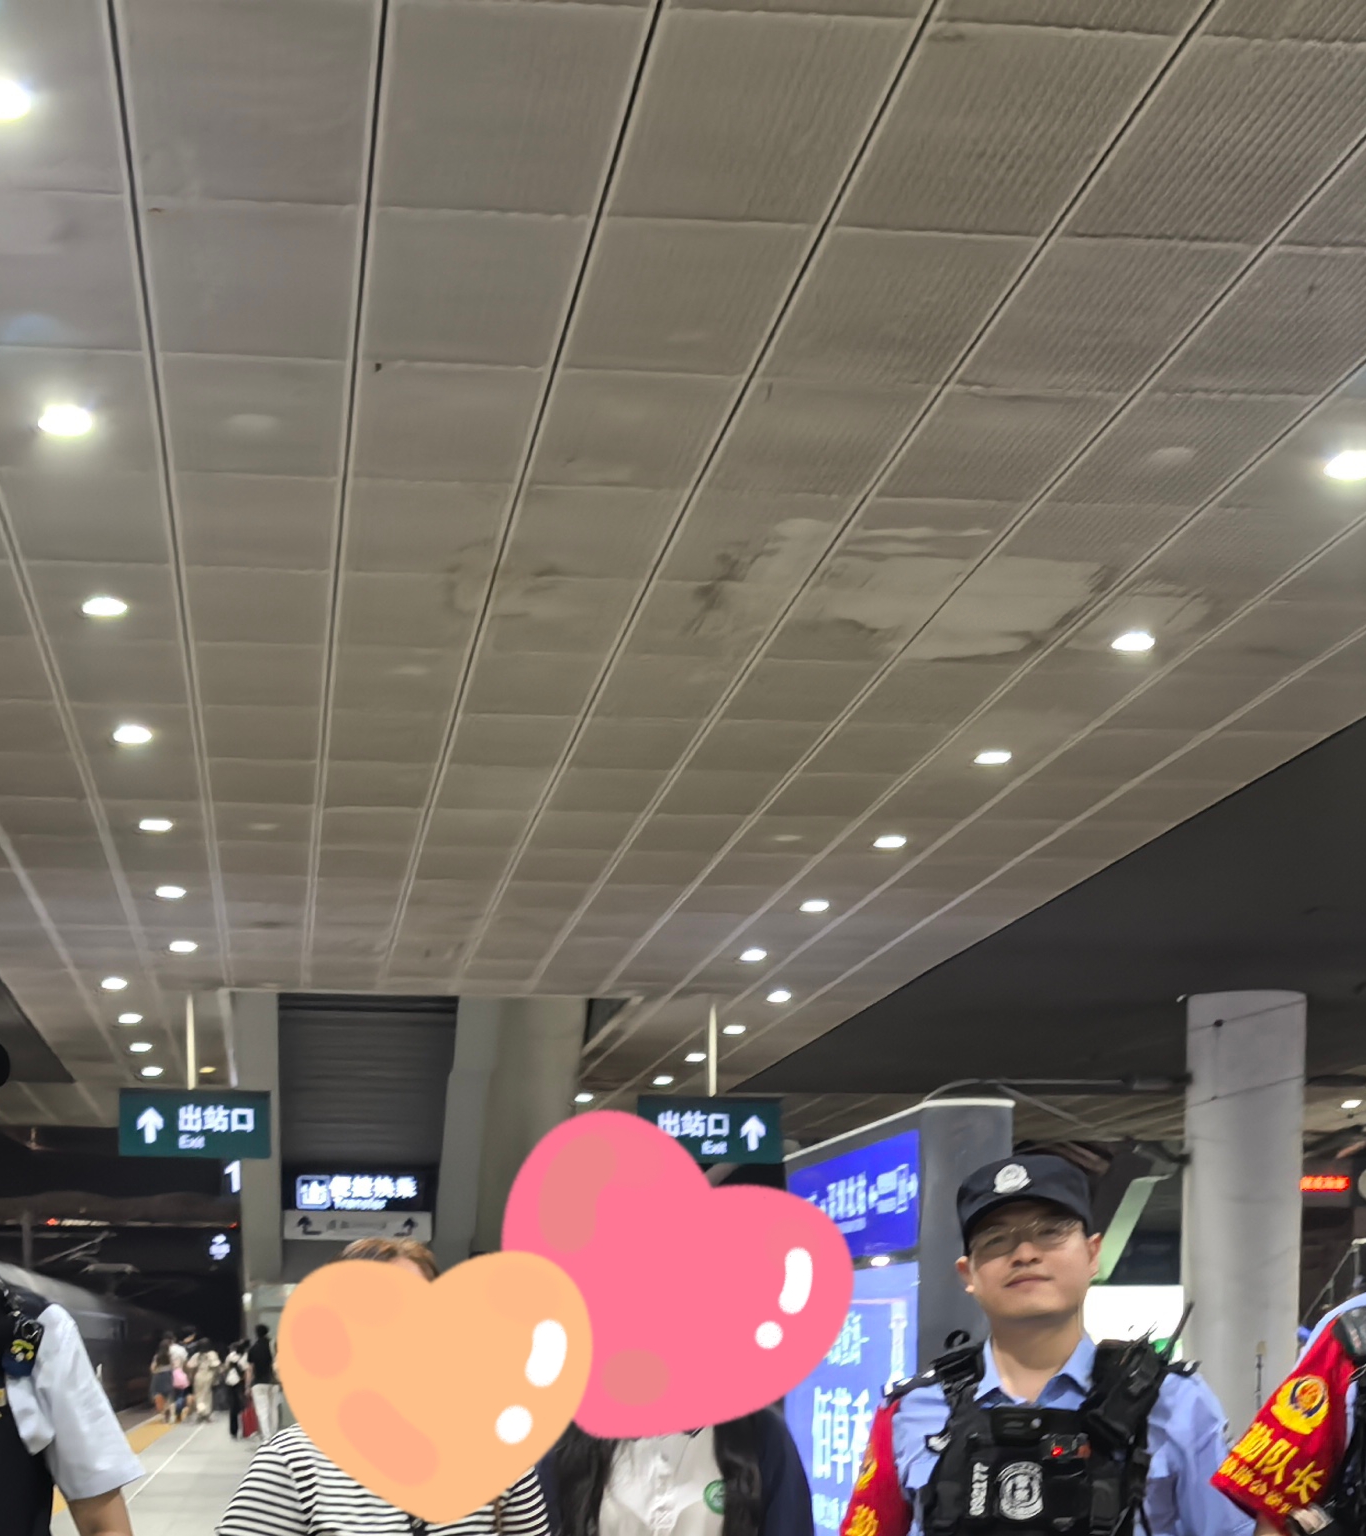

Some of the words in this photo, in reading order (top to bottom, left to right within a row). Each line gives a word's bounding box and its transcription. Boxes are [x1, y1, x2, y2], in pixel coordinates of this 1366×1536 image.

[177, 1104, 255, 1133] 出站口
[657, 1110, 730, 1138] 出站口
[178, 1134, 206, 1149] Exit
